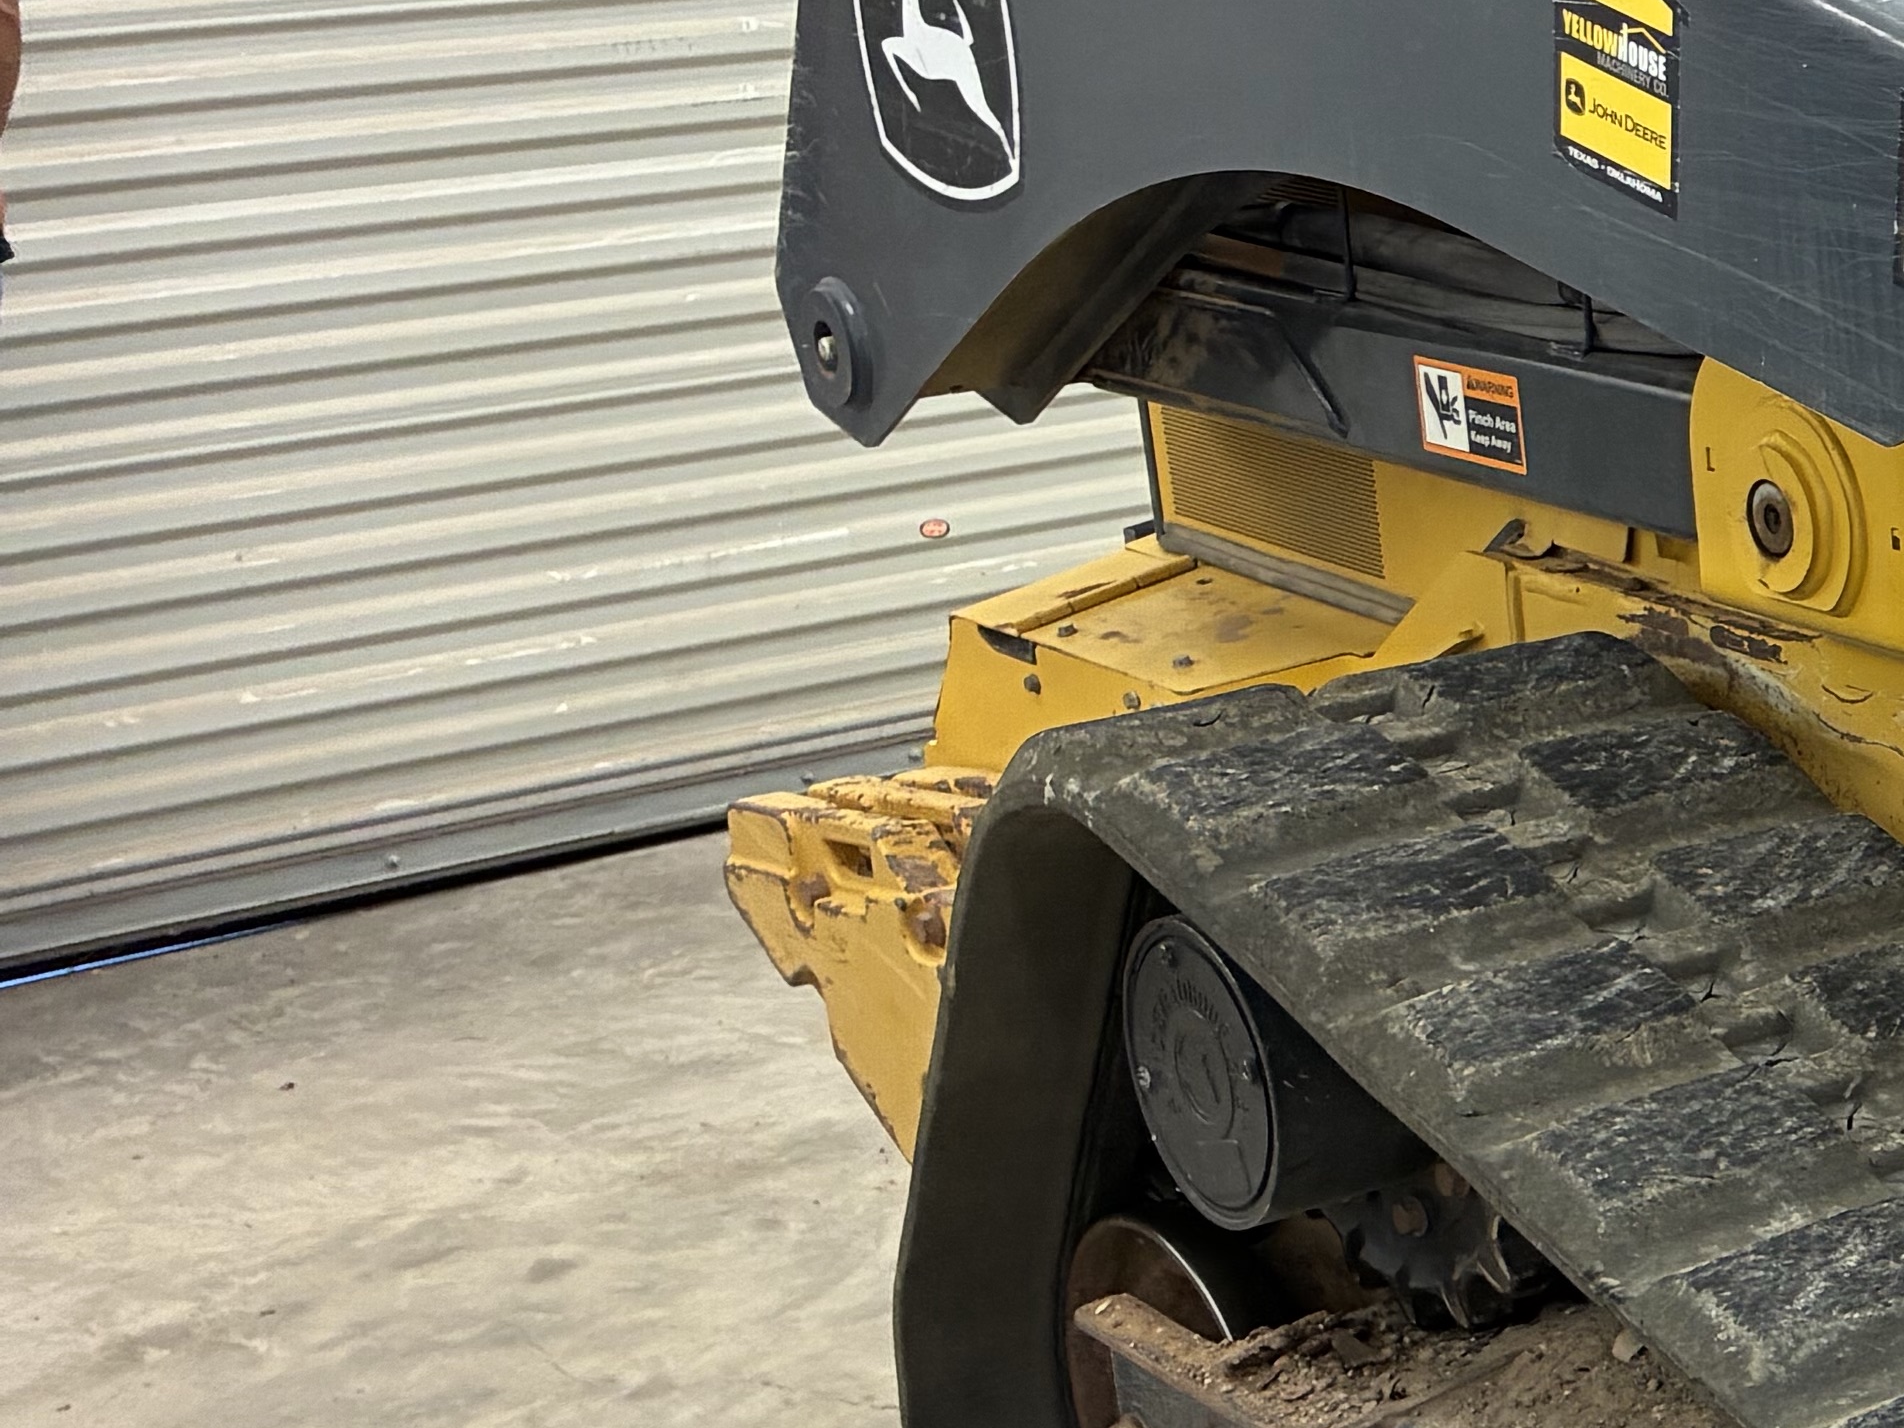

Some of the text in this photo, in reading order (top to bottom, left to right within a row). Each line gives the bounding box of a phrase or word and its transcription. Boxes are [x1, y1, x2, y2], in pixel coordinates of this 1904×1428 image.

[1596, 51, 1670, 97] MACHINERY CO.
[1588, 98, 1667, 150] JOHN DEERE
[1567, 145, 1663, 203] TEXAS OKLAHOMA
[1468, 409, 1517, 434] Pinch Area
[1470, 430, 1512, 454] Keep Away
